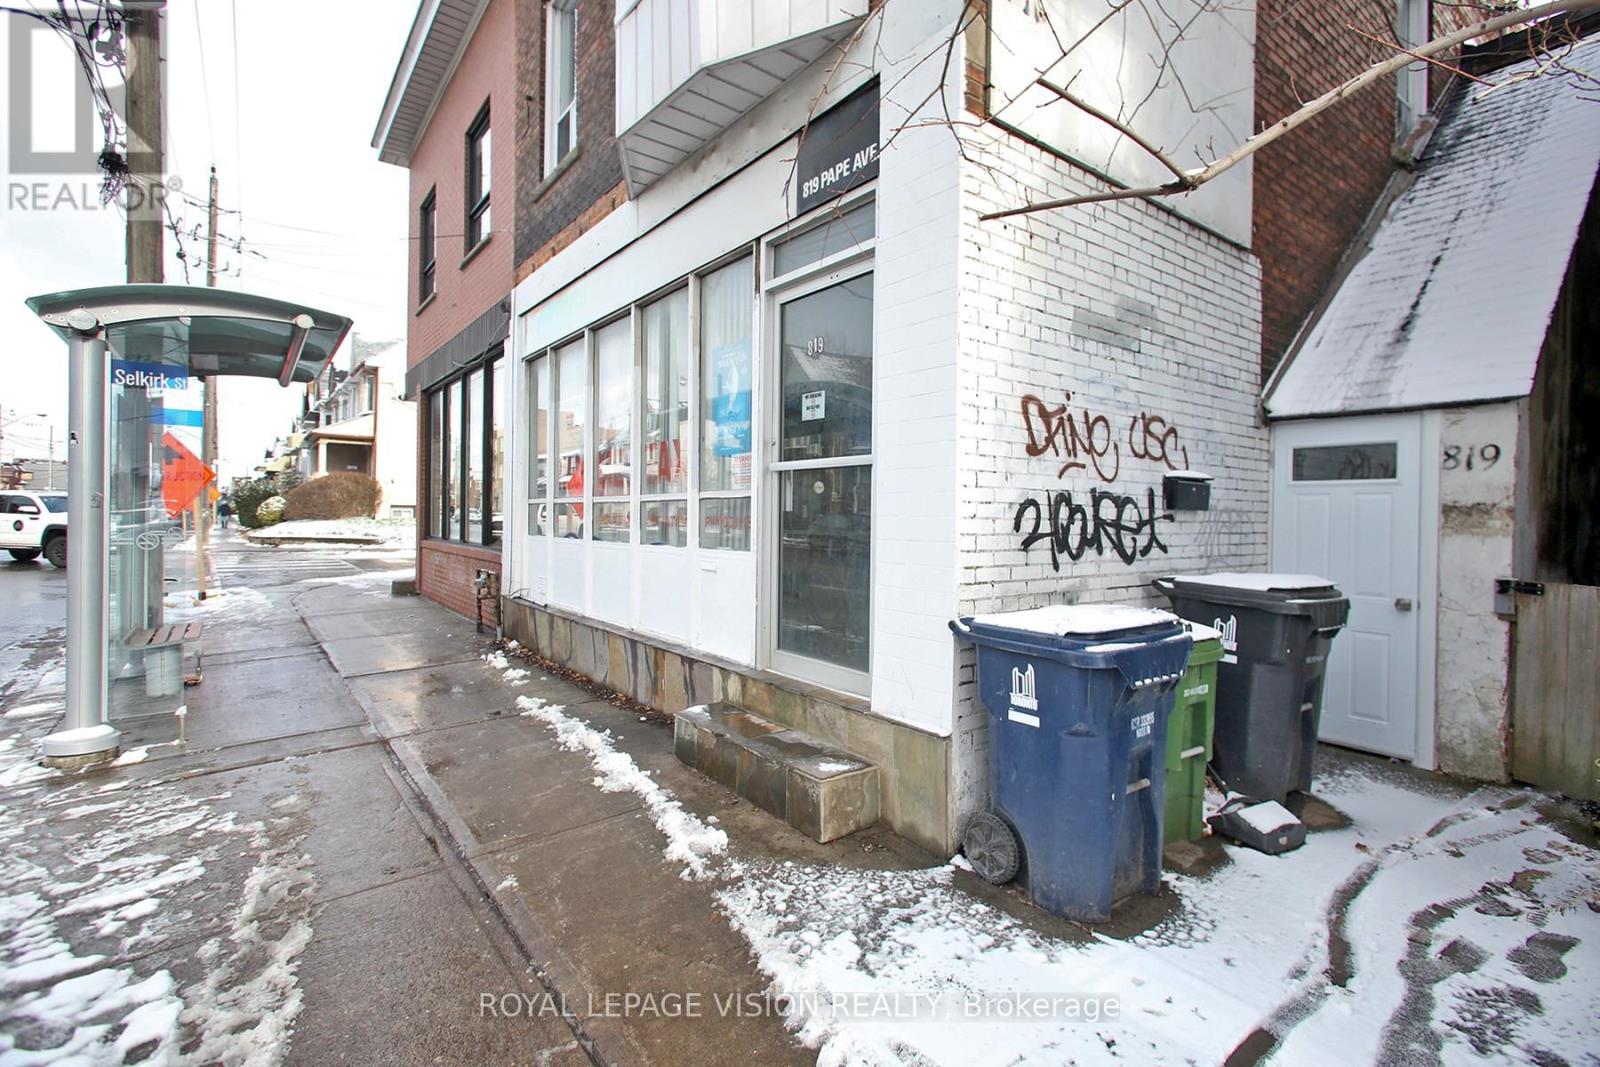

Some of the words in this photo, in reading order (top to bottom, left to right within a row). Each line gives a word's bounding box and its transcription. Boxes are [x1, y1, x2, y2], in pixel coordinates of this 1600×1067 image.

[802, 176, 820, 198] 819
[821, 158, 851, 189] PAPE
[807, 336, 824, 356] 819
[115, 369, 169, 388] Selkirk
[1442, 443, 1501, 472] 819
